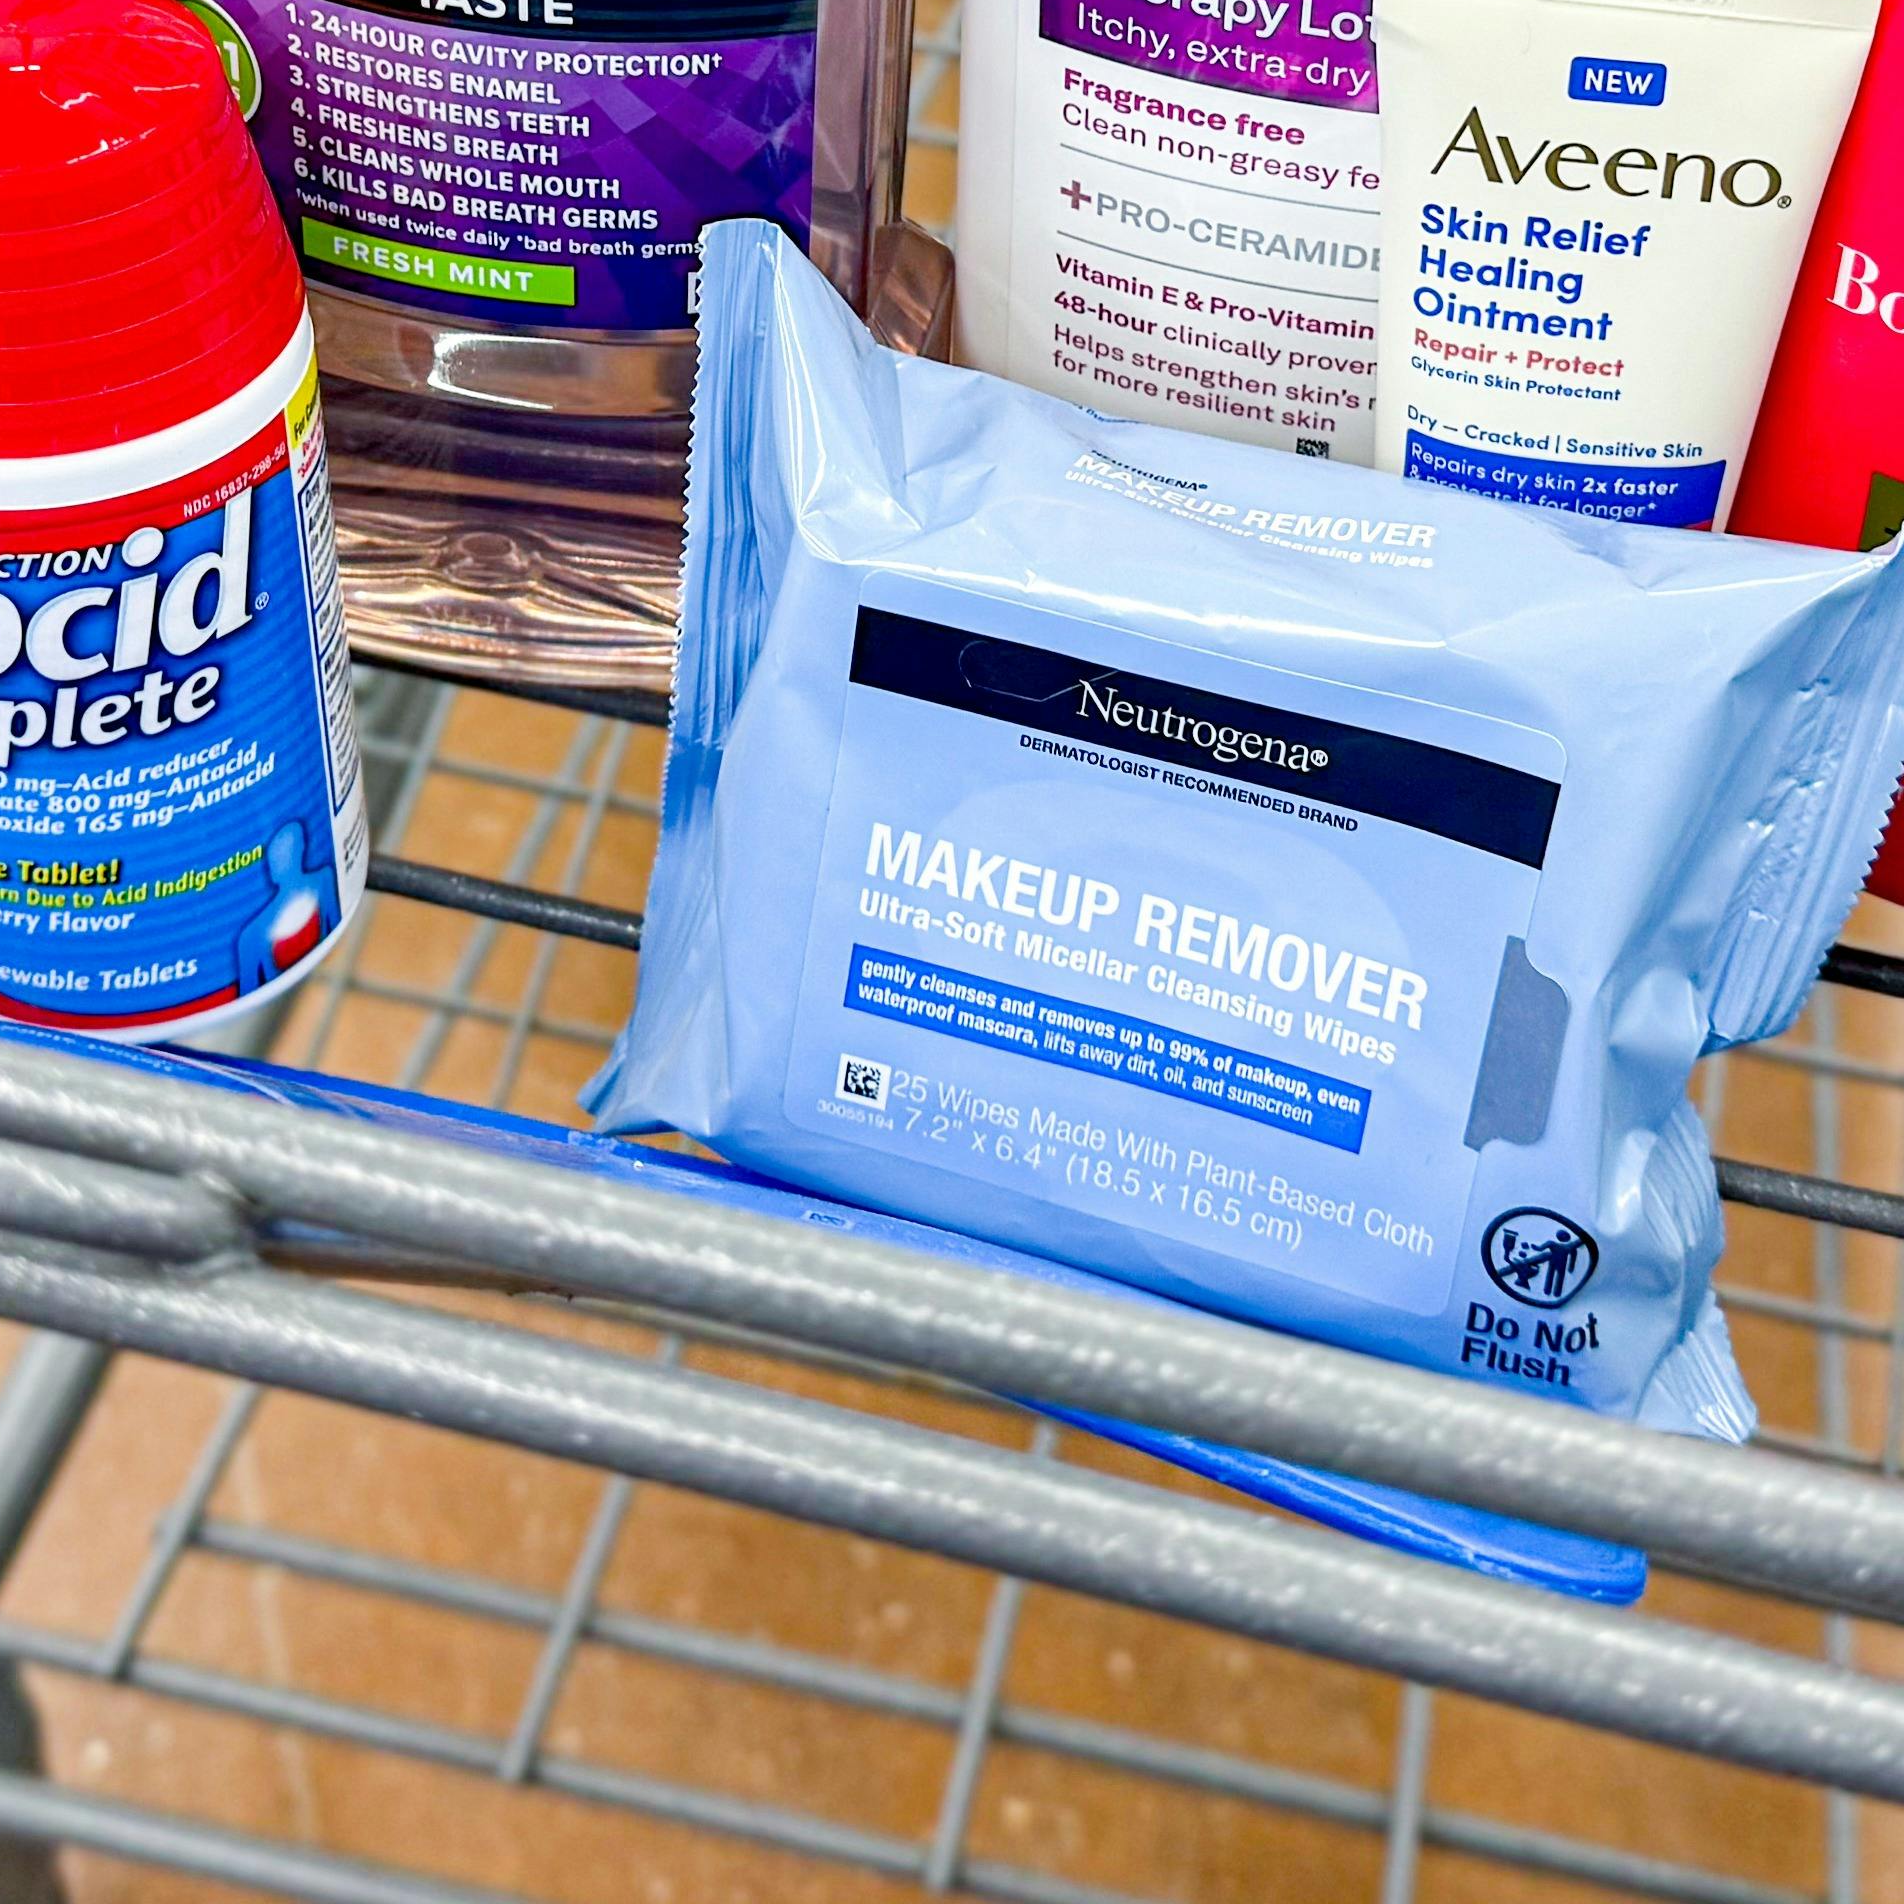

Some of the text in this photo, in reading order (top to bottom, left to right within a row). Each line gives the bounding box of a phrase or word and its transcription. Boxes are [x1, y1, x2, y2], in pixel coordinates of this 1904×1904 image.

[1064, 68, 1305, 145] Fragrance free
[1584, 68, 1654, 96] NEW
[1062, 102, 1339, 190] Clean non-greasy
[294, 157, 659, 230] 6. KILLS BAD BREATH GERMS
[1420, 204, 1651, 258] Skin Relief
[332, 238, 534, 293] FRESH MINT
[1419, 245, 1584, 304] Healing
[1054, 253, 1375, 342] Vitamin E & Pro-Vitamin
[1413, 286, 1613, 342] Ointment
[1410, 356, 1621, 402] Glycerin Skin Protectant
[1414, 328, 1625, 378] Repair + Protect
[18, 860, 121, 887] Tablet!
[49, 910, 135, 932] Flavor
[864, 823, 1429, 1031] MAKEUP REMOVER
[100, 956, 198, 991] Tablets
[858, 888, 1397, 1066] Ultra-Soft Micellar Cleansing Wipes
[1465, 1301, 1600, 1355] Do Not
[1459, 1337, 1572, 1386] Flush
